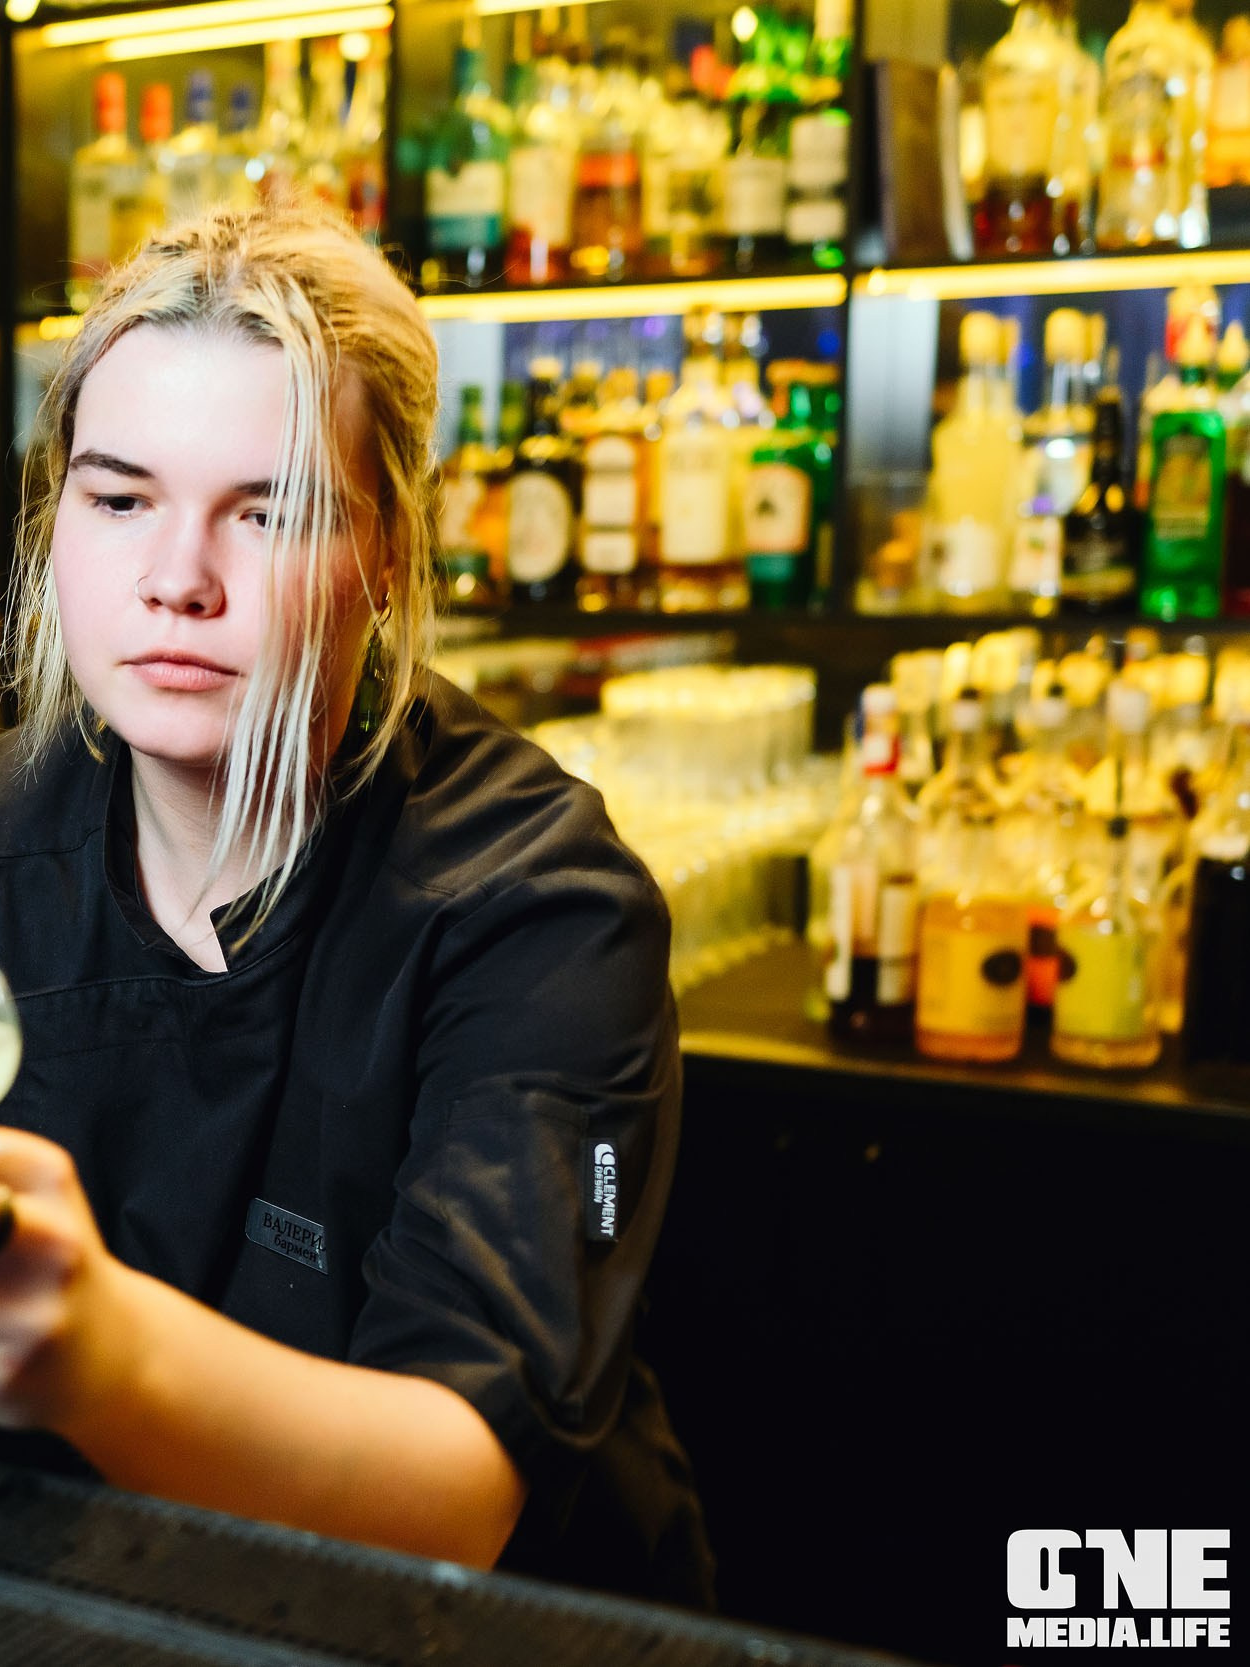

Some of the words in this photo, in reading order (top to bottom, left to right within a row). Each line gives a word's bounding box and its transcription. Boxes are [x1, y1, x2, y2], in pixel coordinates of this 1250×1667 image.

[593, 1165, 603, 1204] DESIGN
[600, 1166, 617, 1237] CLEMENT
[262, 1212, 327, 1251] ВАЛЕРИ
[274, 1234, 317, 1262] бармен
